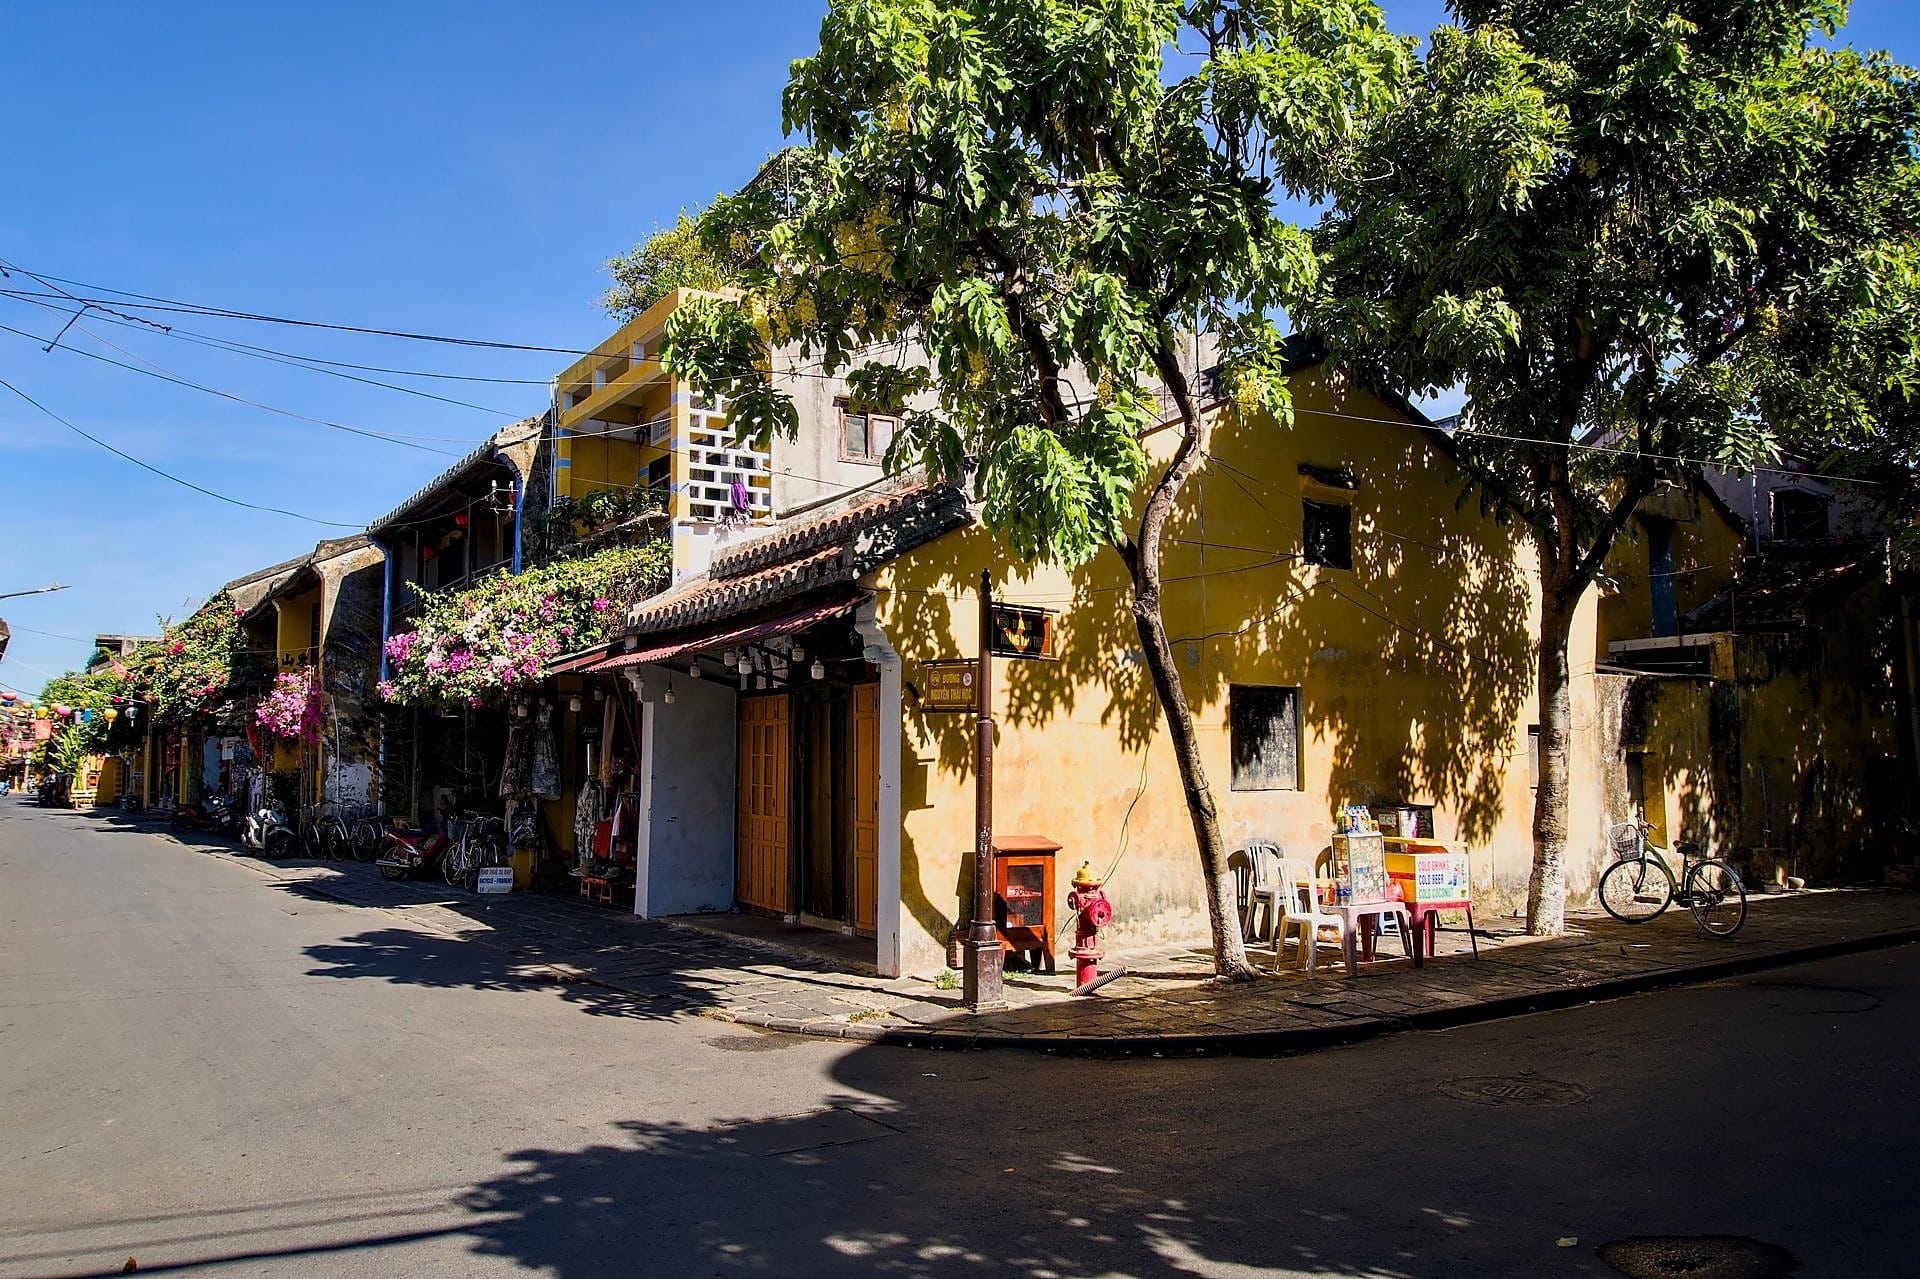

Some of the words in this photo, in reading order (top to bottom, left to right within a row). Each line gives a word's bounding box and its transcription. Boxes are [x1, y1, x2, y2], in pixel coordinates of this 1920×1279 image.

[1418, 861, 1431, 871] COLD
[1419, 874, 1431, 885] COLD
[1432, 874, 1444, 885] BEER
[1419, 888, 1431, 899] COLD
[1432, 887, 1453, 898] COCONUT
